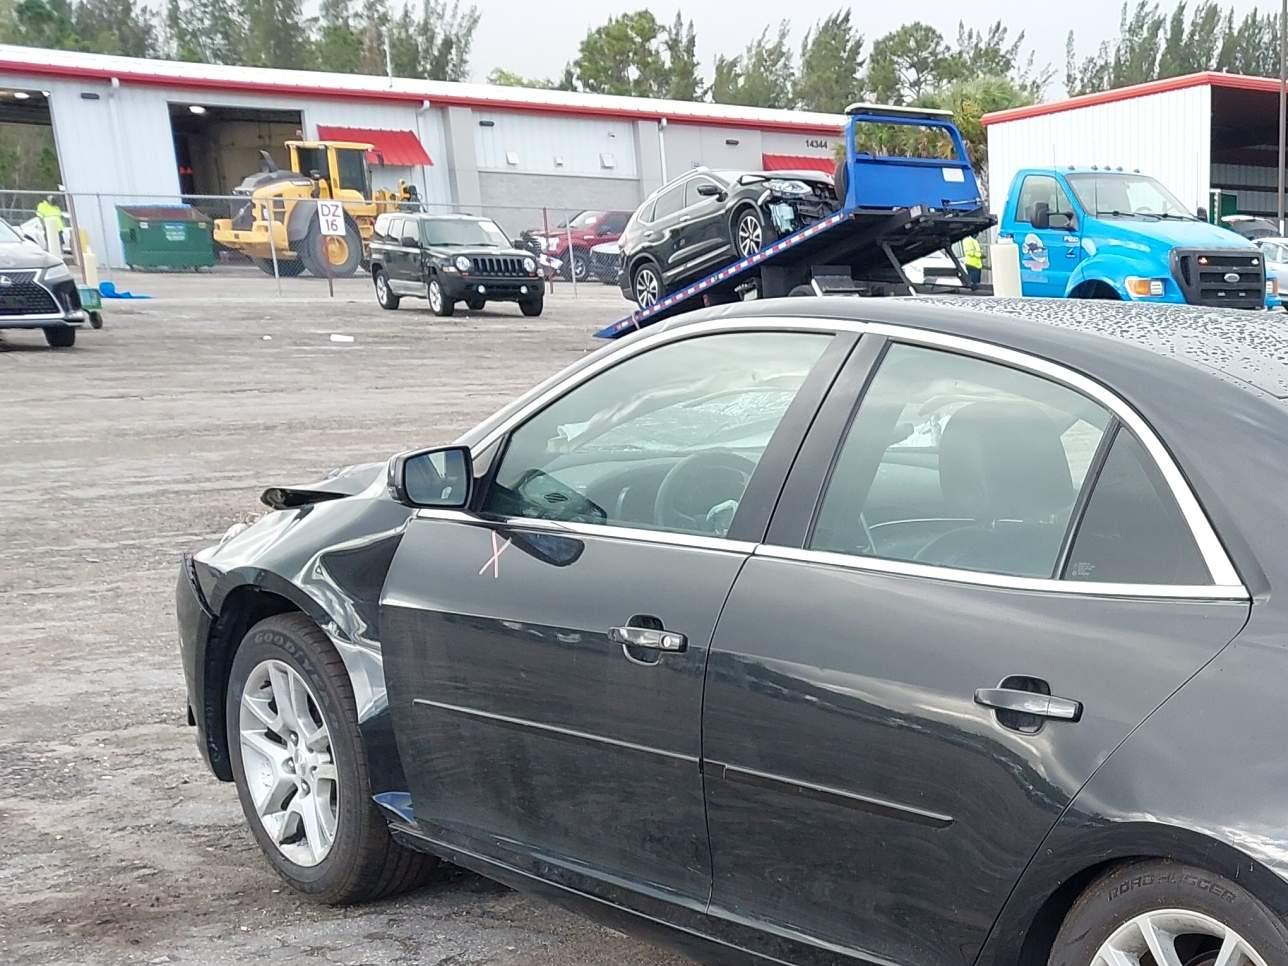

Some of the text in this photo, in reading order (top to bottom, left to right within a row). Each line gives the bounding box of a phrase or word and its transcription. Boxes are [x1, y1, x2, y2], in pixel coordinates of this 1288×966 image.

[805, 139, 828, 149] 14344
[320, 203, 342, 217] DZ
[324, 218, 339, 232] 16
